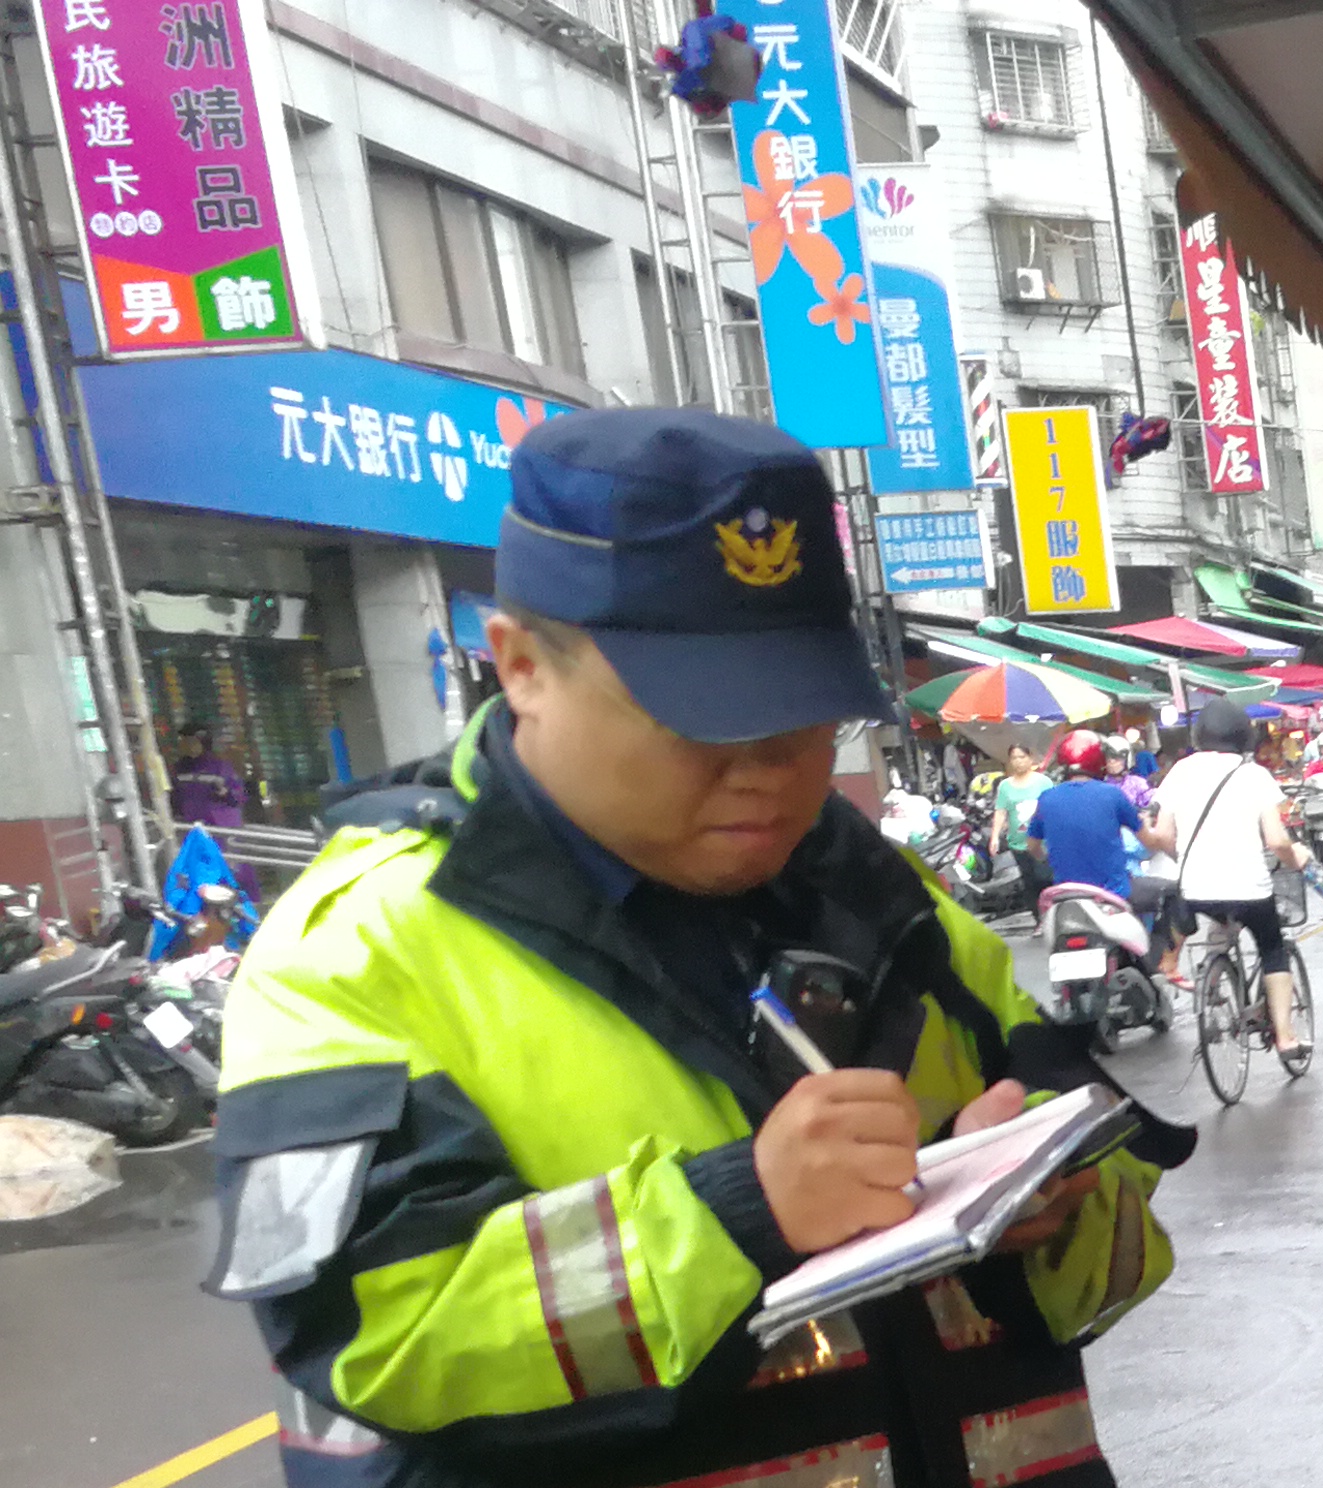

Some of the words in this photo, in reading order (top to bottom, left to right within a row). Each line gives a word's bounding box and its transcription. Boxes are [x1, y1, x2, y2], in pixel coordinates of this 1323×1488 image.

[158, 1, 263, 233] 洲精品
[753, 23, 825, 235] 元大銀行
[120, 275, 277, 336] 男飾
[269, 386, 422, 483] 元大銀行
